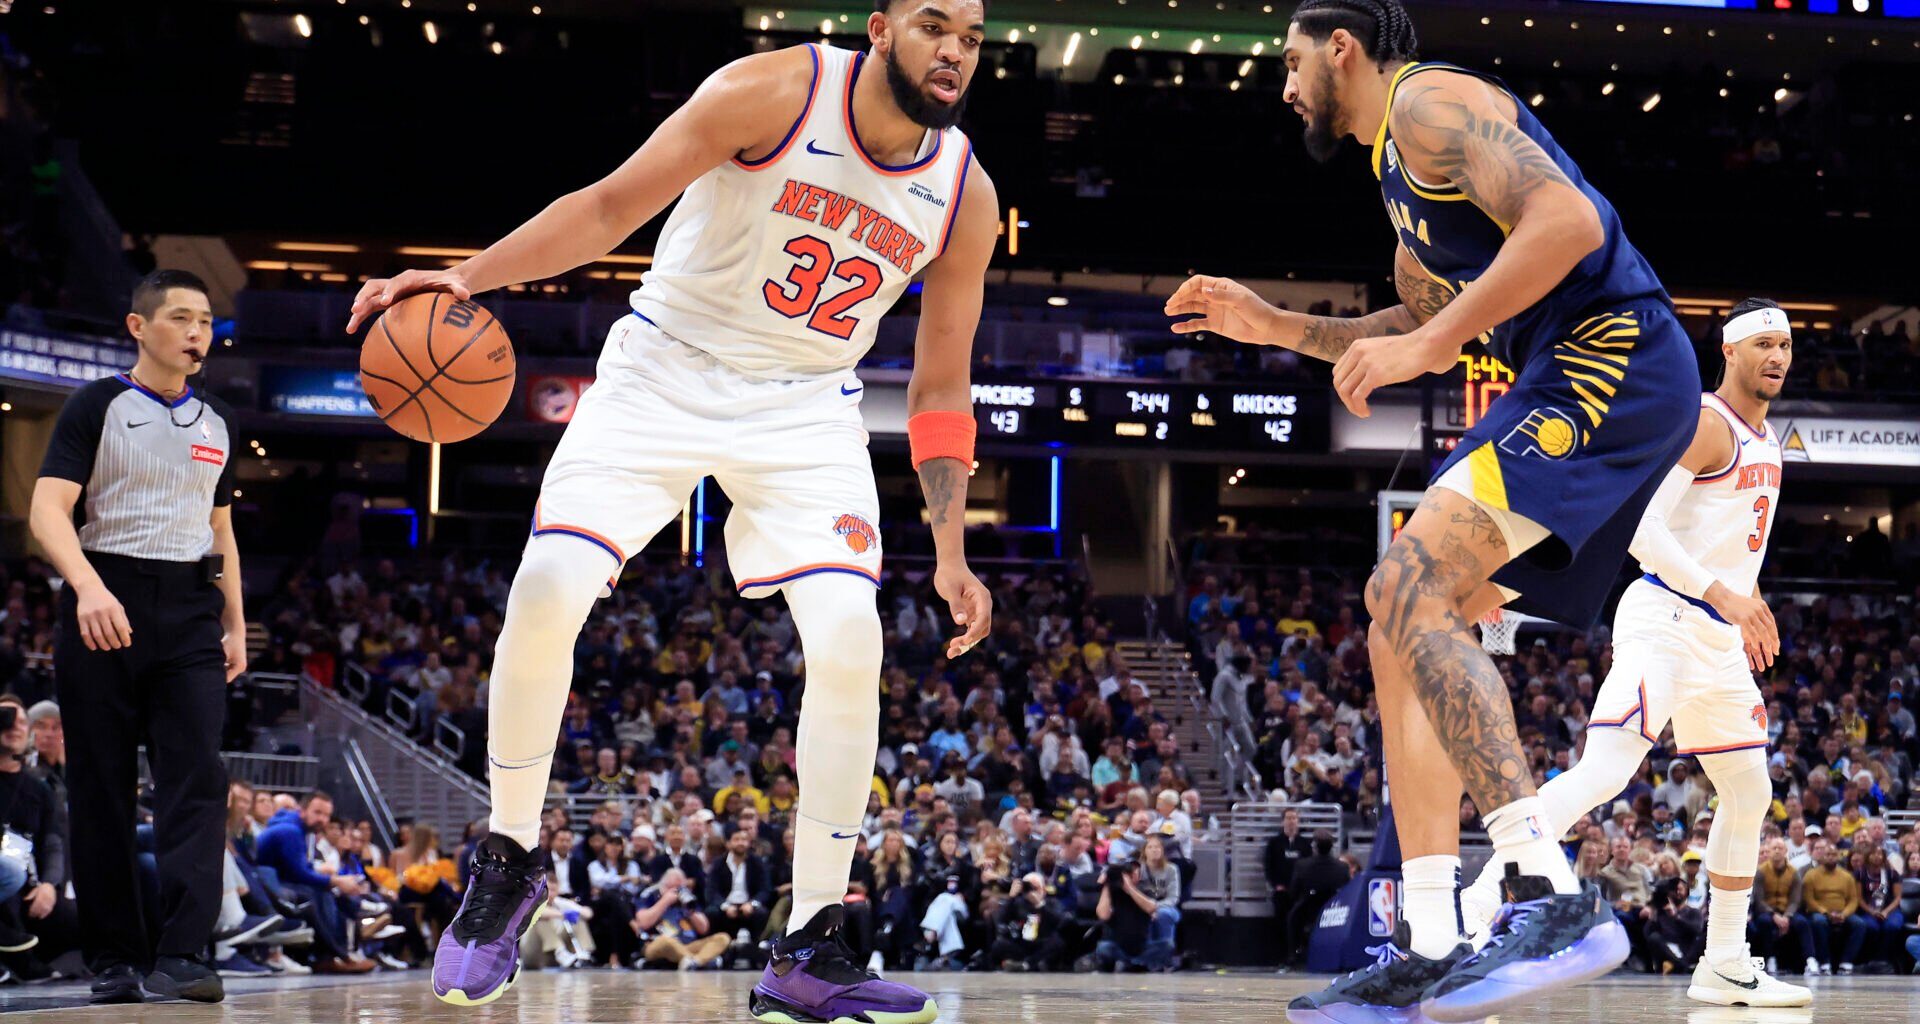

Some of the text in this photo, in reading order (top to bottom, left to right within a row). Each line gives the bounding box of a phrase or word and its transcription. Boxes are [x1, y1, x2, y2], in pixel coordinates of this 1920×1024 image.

[908, 187, 946, 208] abu dhabi
[771, 178, 926, 275] NEW YORK
[762, 234, 883, 341] 32
[971, 384, 1035, 406] PACERS
[1126, 390, 1170, 413] 7:44
[1233, 393, 1297, 415] KNICKS
[990, 410, 1019, 434] 43
[1155, 421, 1169, 440] 2
[1264, 419, 1293, 442] 42
[1810, 429, 1920, 446] LIFT ACADEM
[192, 447, 224, 464] Emirates
[1735, 462, 1764, 490] NEW
[1747, 495, 1770, 552] 3
